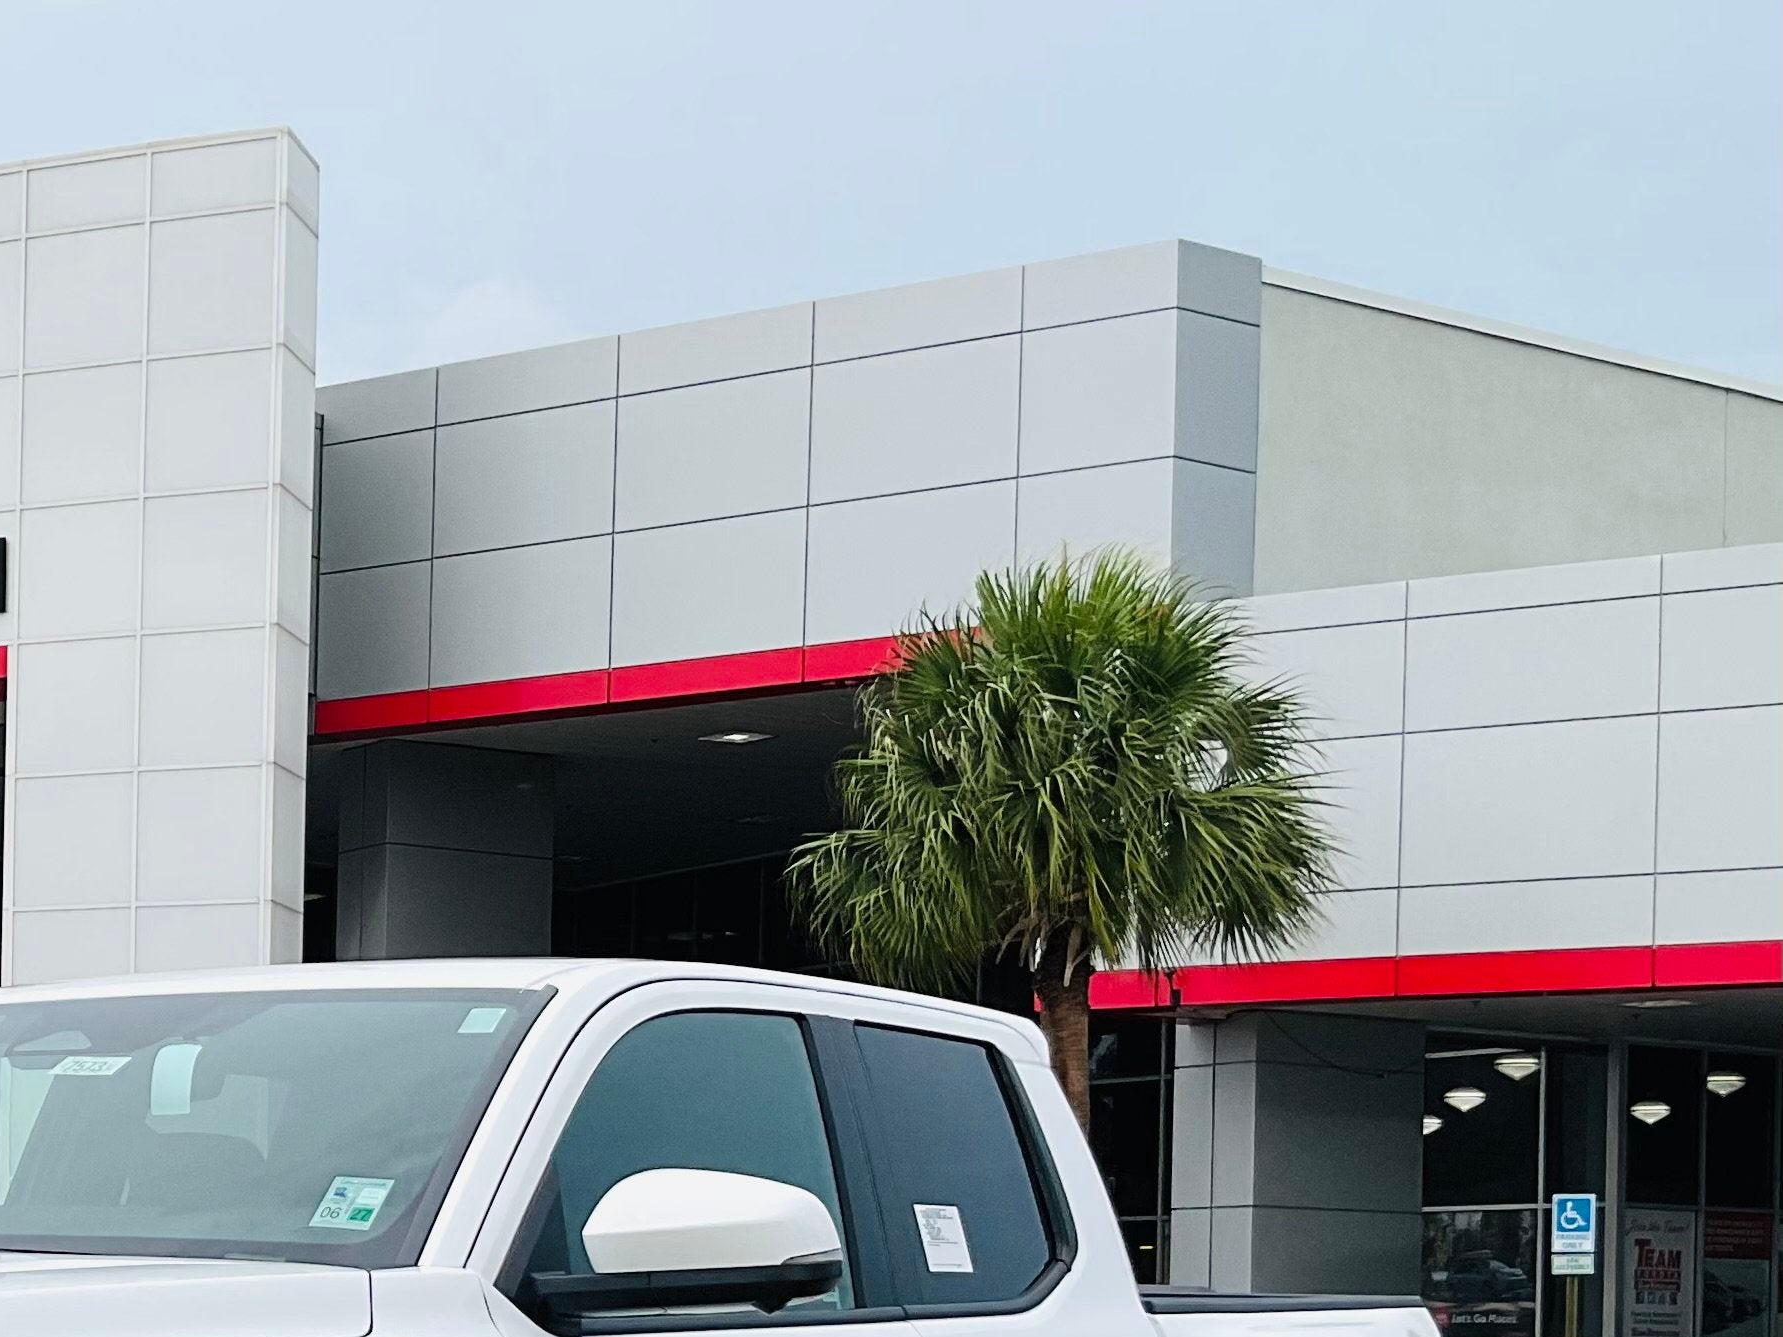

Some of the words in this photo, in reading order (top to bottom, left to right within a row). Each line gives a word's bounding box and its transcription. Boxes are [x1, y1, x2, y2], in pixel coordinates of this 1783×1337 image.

[320, 1206, 342, 1219] 06
[349, 1208, 375, 1221] 27
[1635, 1239, 1681, 1268] TEAM
[1473, 1313, 1487, 1323] Go
